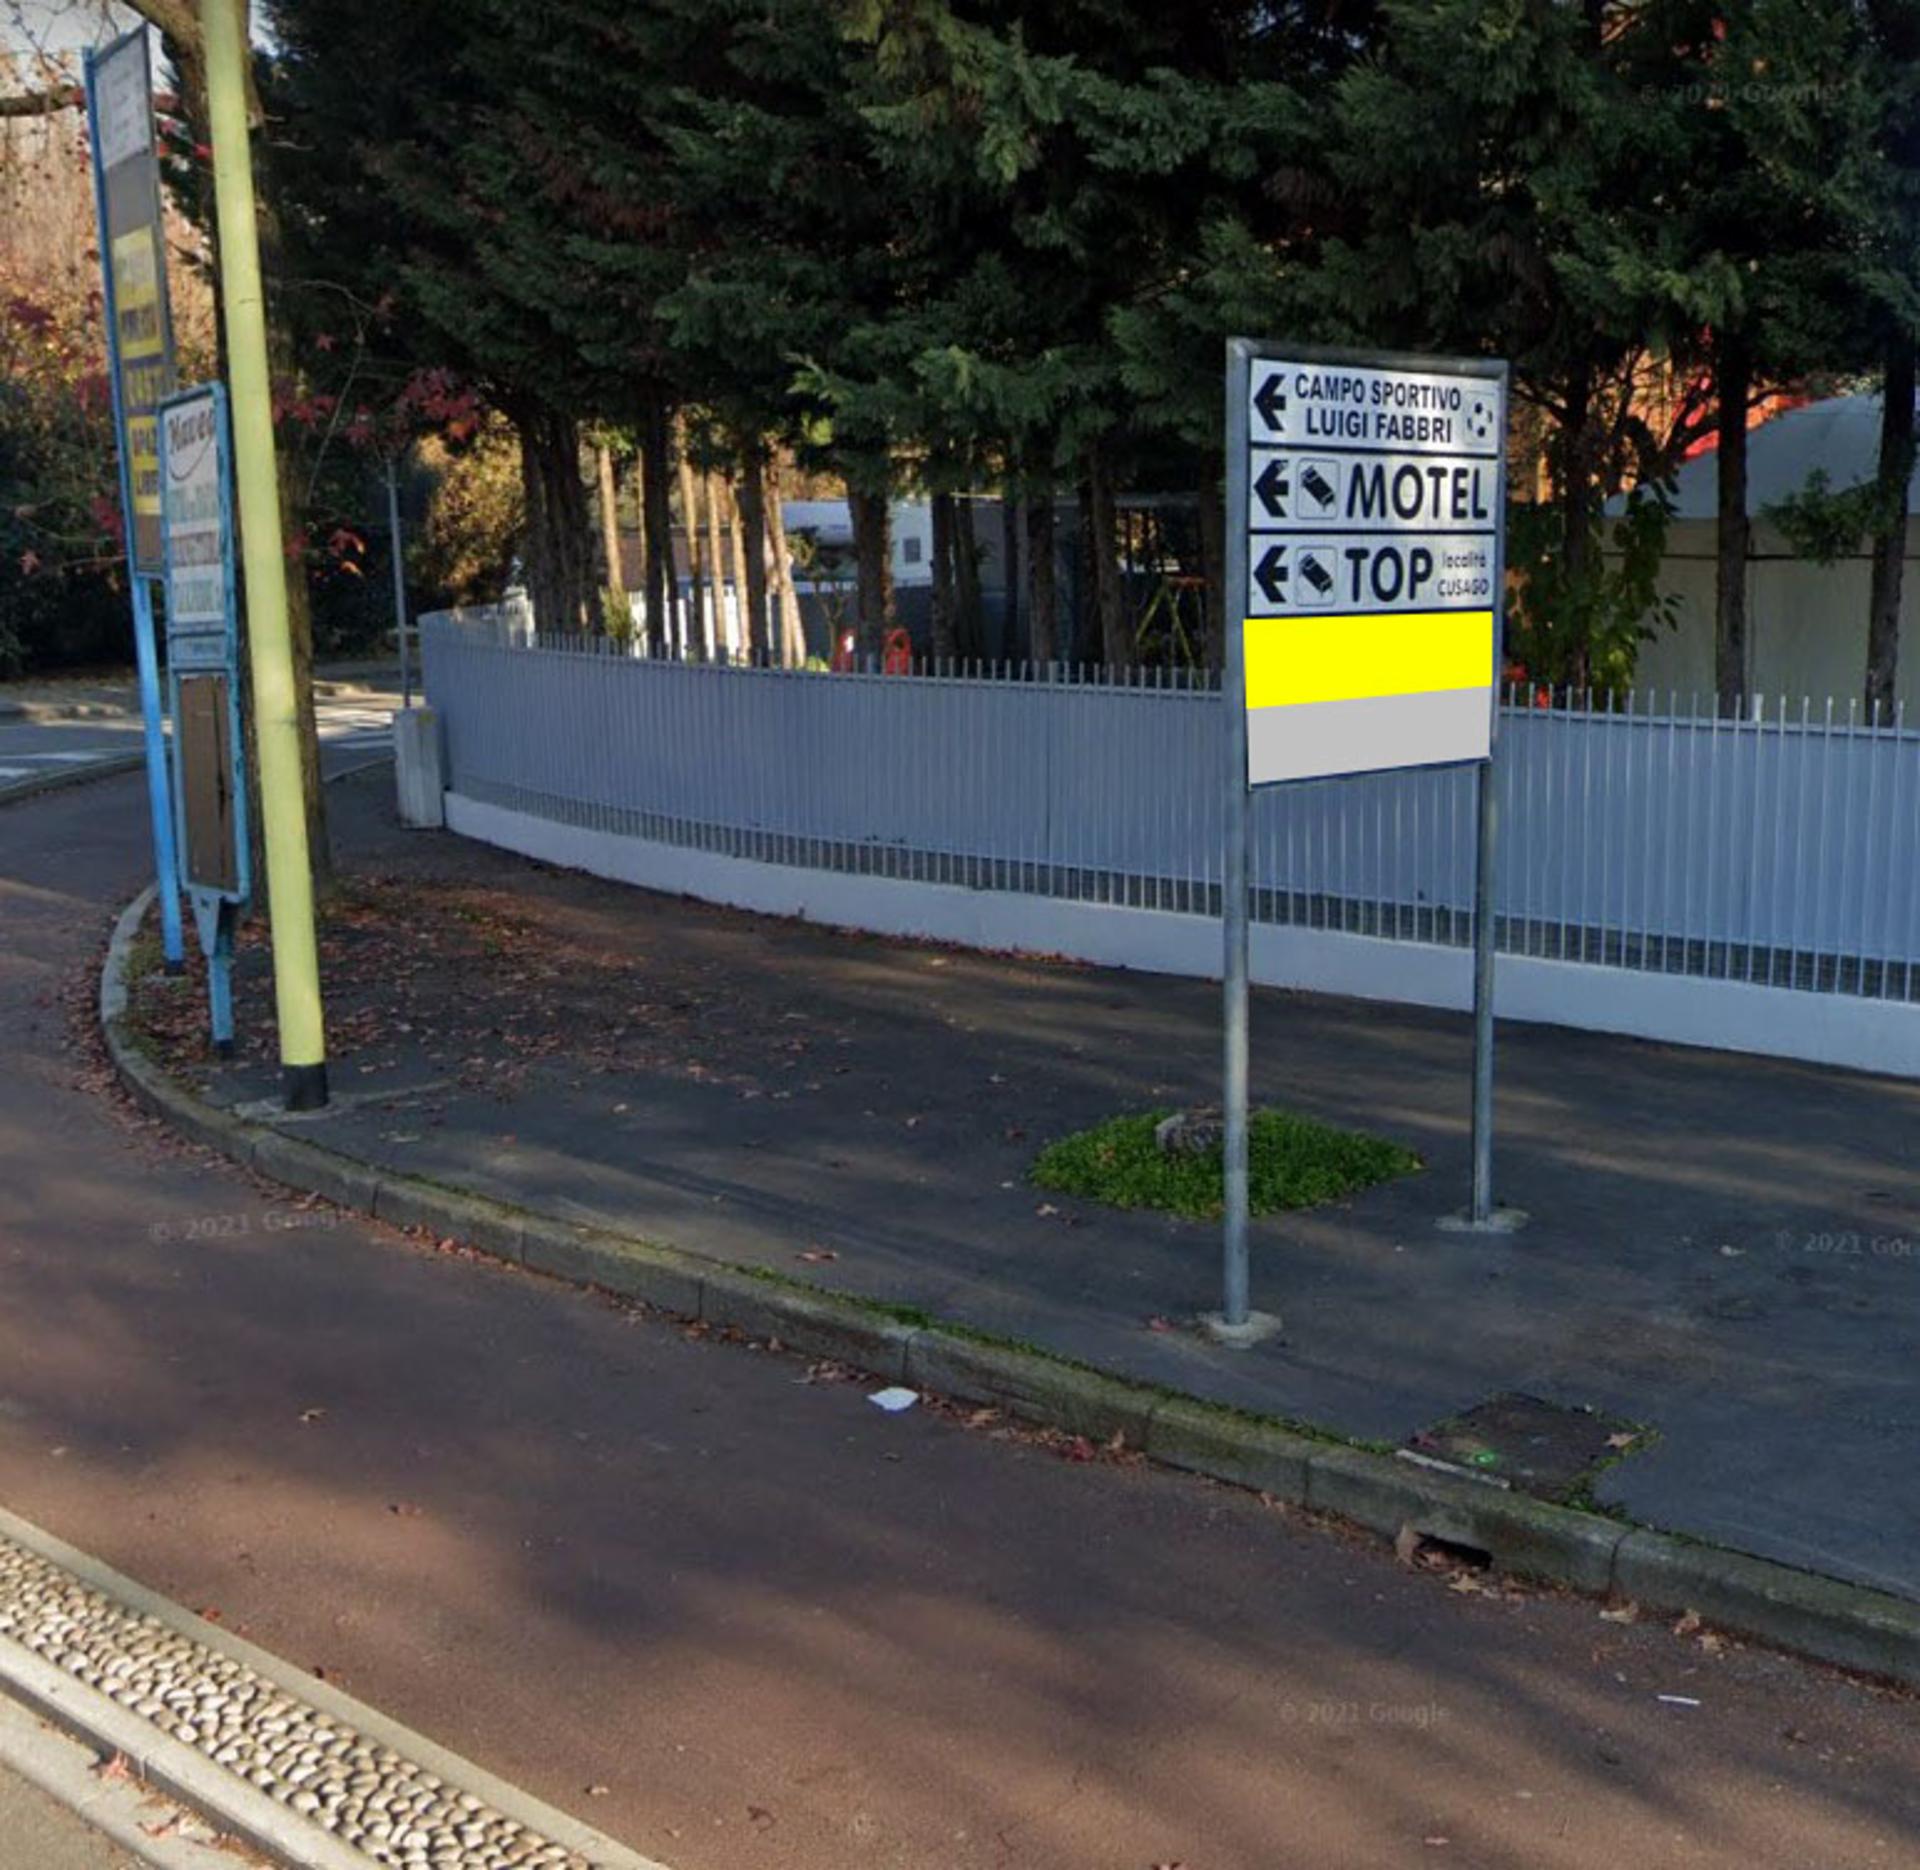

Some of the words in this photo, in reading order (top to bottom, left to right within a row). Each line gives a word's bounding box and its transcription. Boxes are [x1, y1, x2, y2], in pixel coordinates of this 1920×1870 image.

[1295, 373, 1366, 403] CAMPO
[1371, 379, 1461, 411] SPORTIVO
[1306, 407, 1367, 438] LUIGI
[1376, 413, 1453, 443] FABBRI
[1346, 463, 1488, 520] MOTEL
[1345, 546, 1433, 602] TOP
[1437, 578, 1490, 597] CUSAGO
